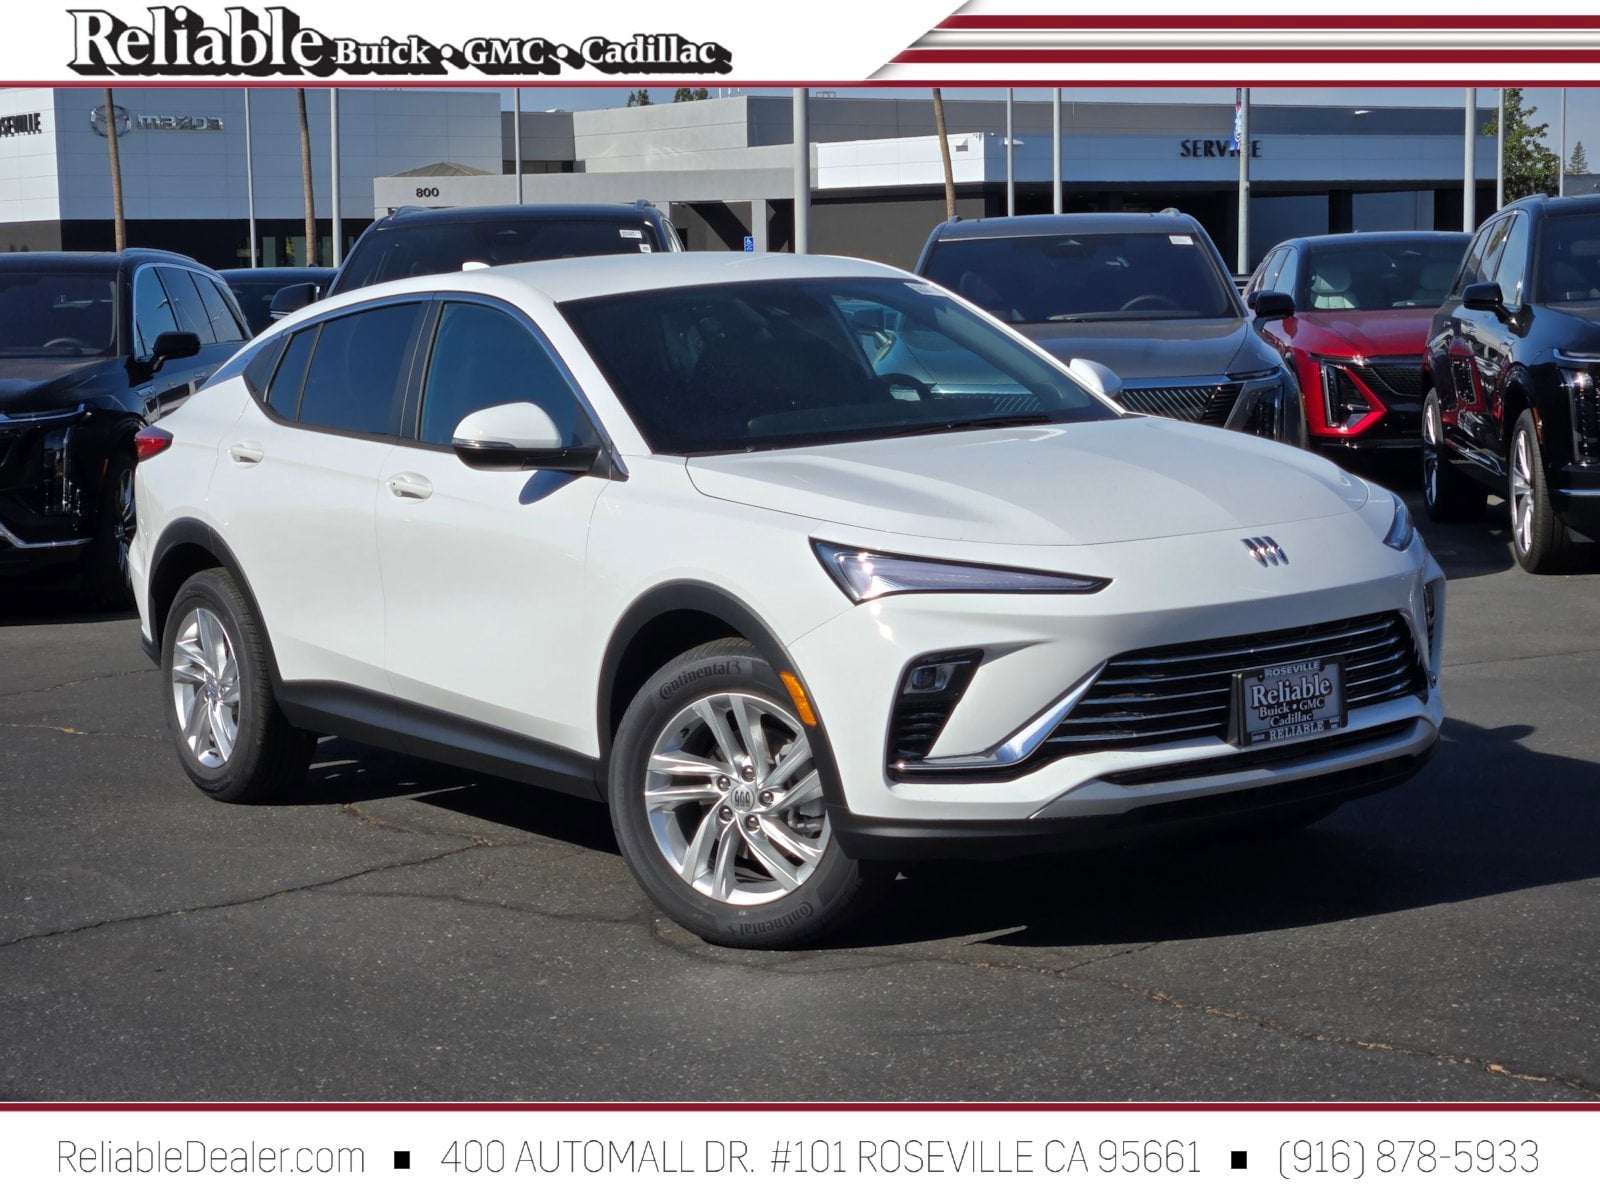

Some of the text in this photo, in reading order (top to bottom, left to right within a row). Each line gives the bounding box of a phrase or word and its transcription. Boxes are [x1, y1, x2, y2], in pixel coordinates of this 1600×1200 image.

[1180, 140, 1262, 158] SERVE
[415, 187, 440, 198] 800
[1264, 661, 1320, 678] ROSEVILLE
[659, 661, 730, 700] Continental
[1251, 674, 1331, 708] Reliable
[1259, 696, 1325, 719] Buick GMC
[1269, 711, 1313, 728] Cadillac
[1268, 720, 1325, 741] RELIABLE
